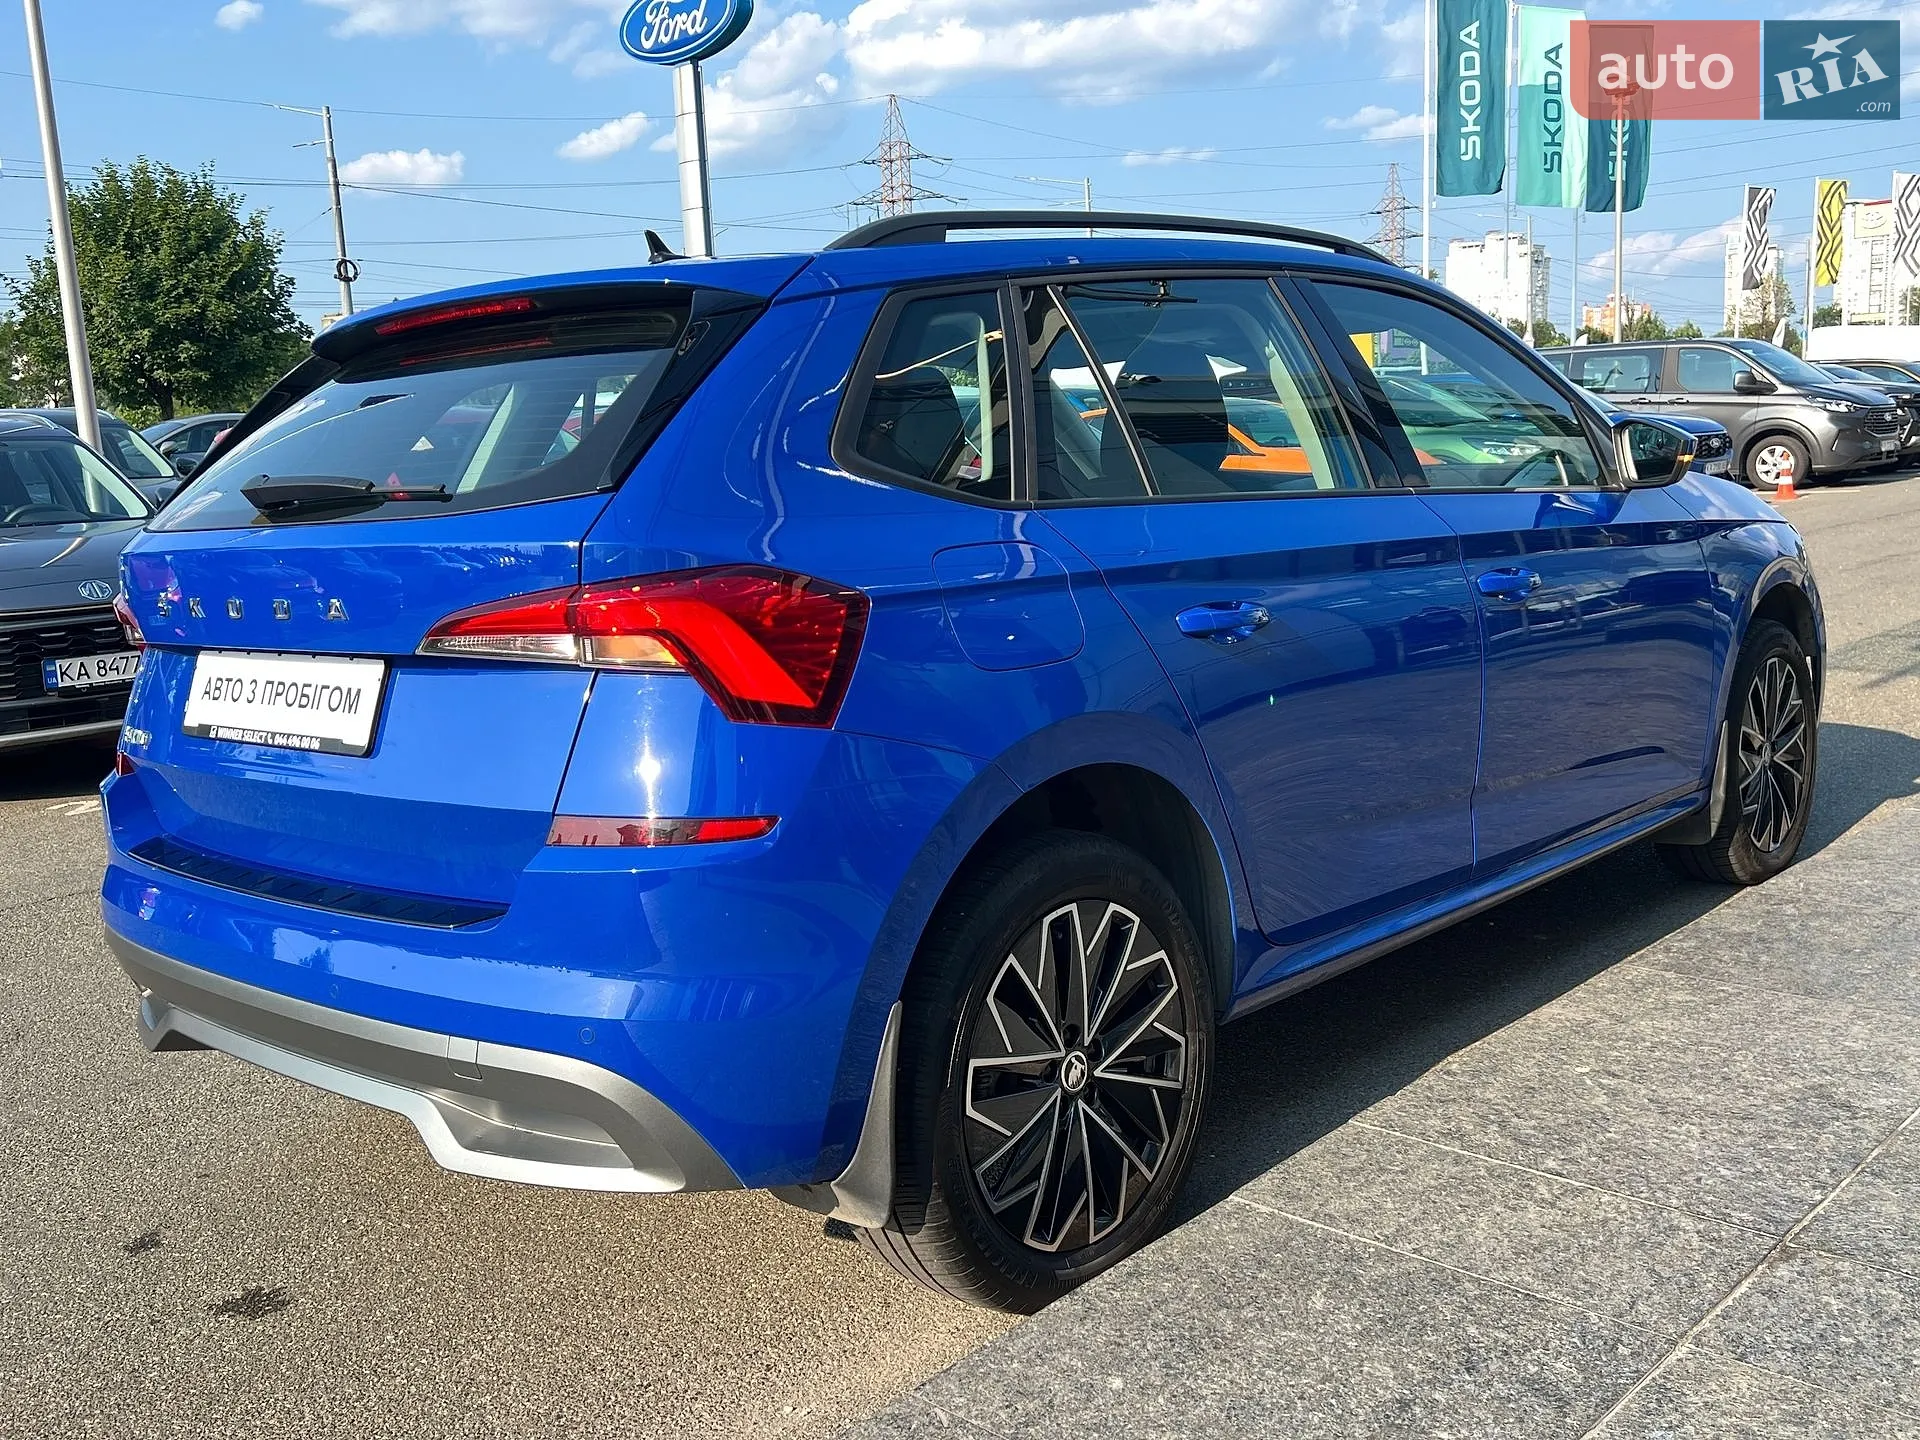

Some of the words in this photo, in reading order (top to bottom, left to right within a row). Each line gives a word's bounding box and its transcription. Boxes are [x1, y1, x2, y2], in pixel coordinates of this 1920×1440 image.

[640, 0, 708, 50] Ford
[80, 581, 111, 599] MG
[58, 661, 91, 682] KA
[96, 655, 141, 678] 8477
[201, 676, 244, 703] АВТО
[261, 680, 362, 715] ПРОБІГОМ
[242, 730, 267, 744] SELECT
